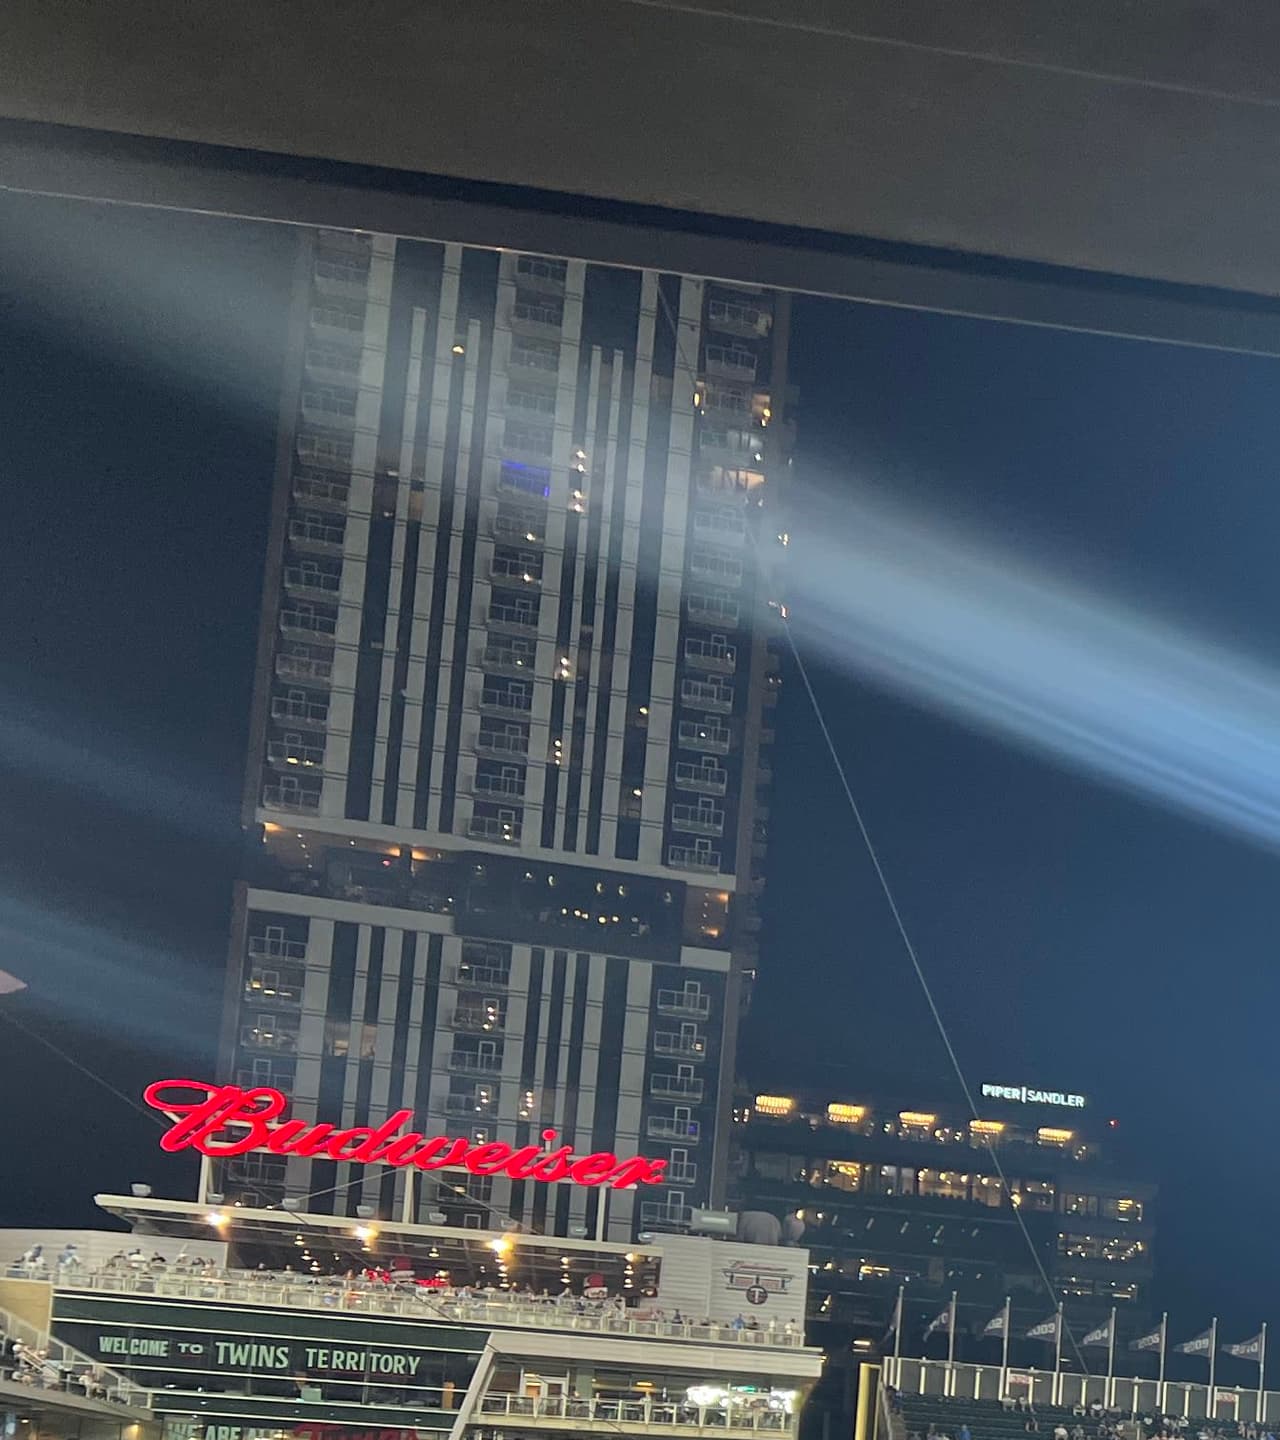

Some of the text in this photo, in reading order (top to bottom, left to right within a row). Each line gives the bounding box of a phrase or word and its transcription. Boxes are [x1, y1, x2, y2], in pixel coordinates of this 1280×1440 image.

[982, 1084, 1084, 1108] PIPER SANDLER
[143, 1079, 667, 1189] Budweiser
[99, 1336, 421, 1376] WELCOME TO TWINS TERRITORY
